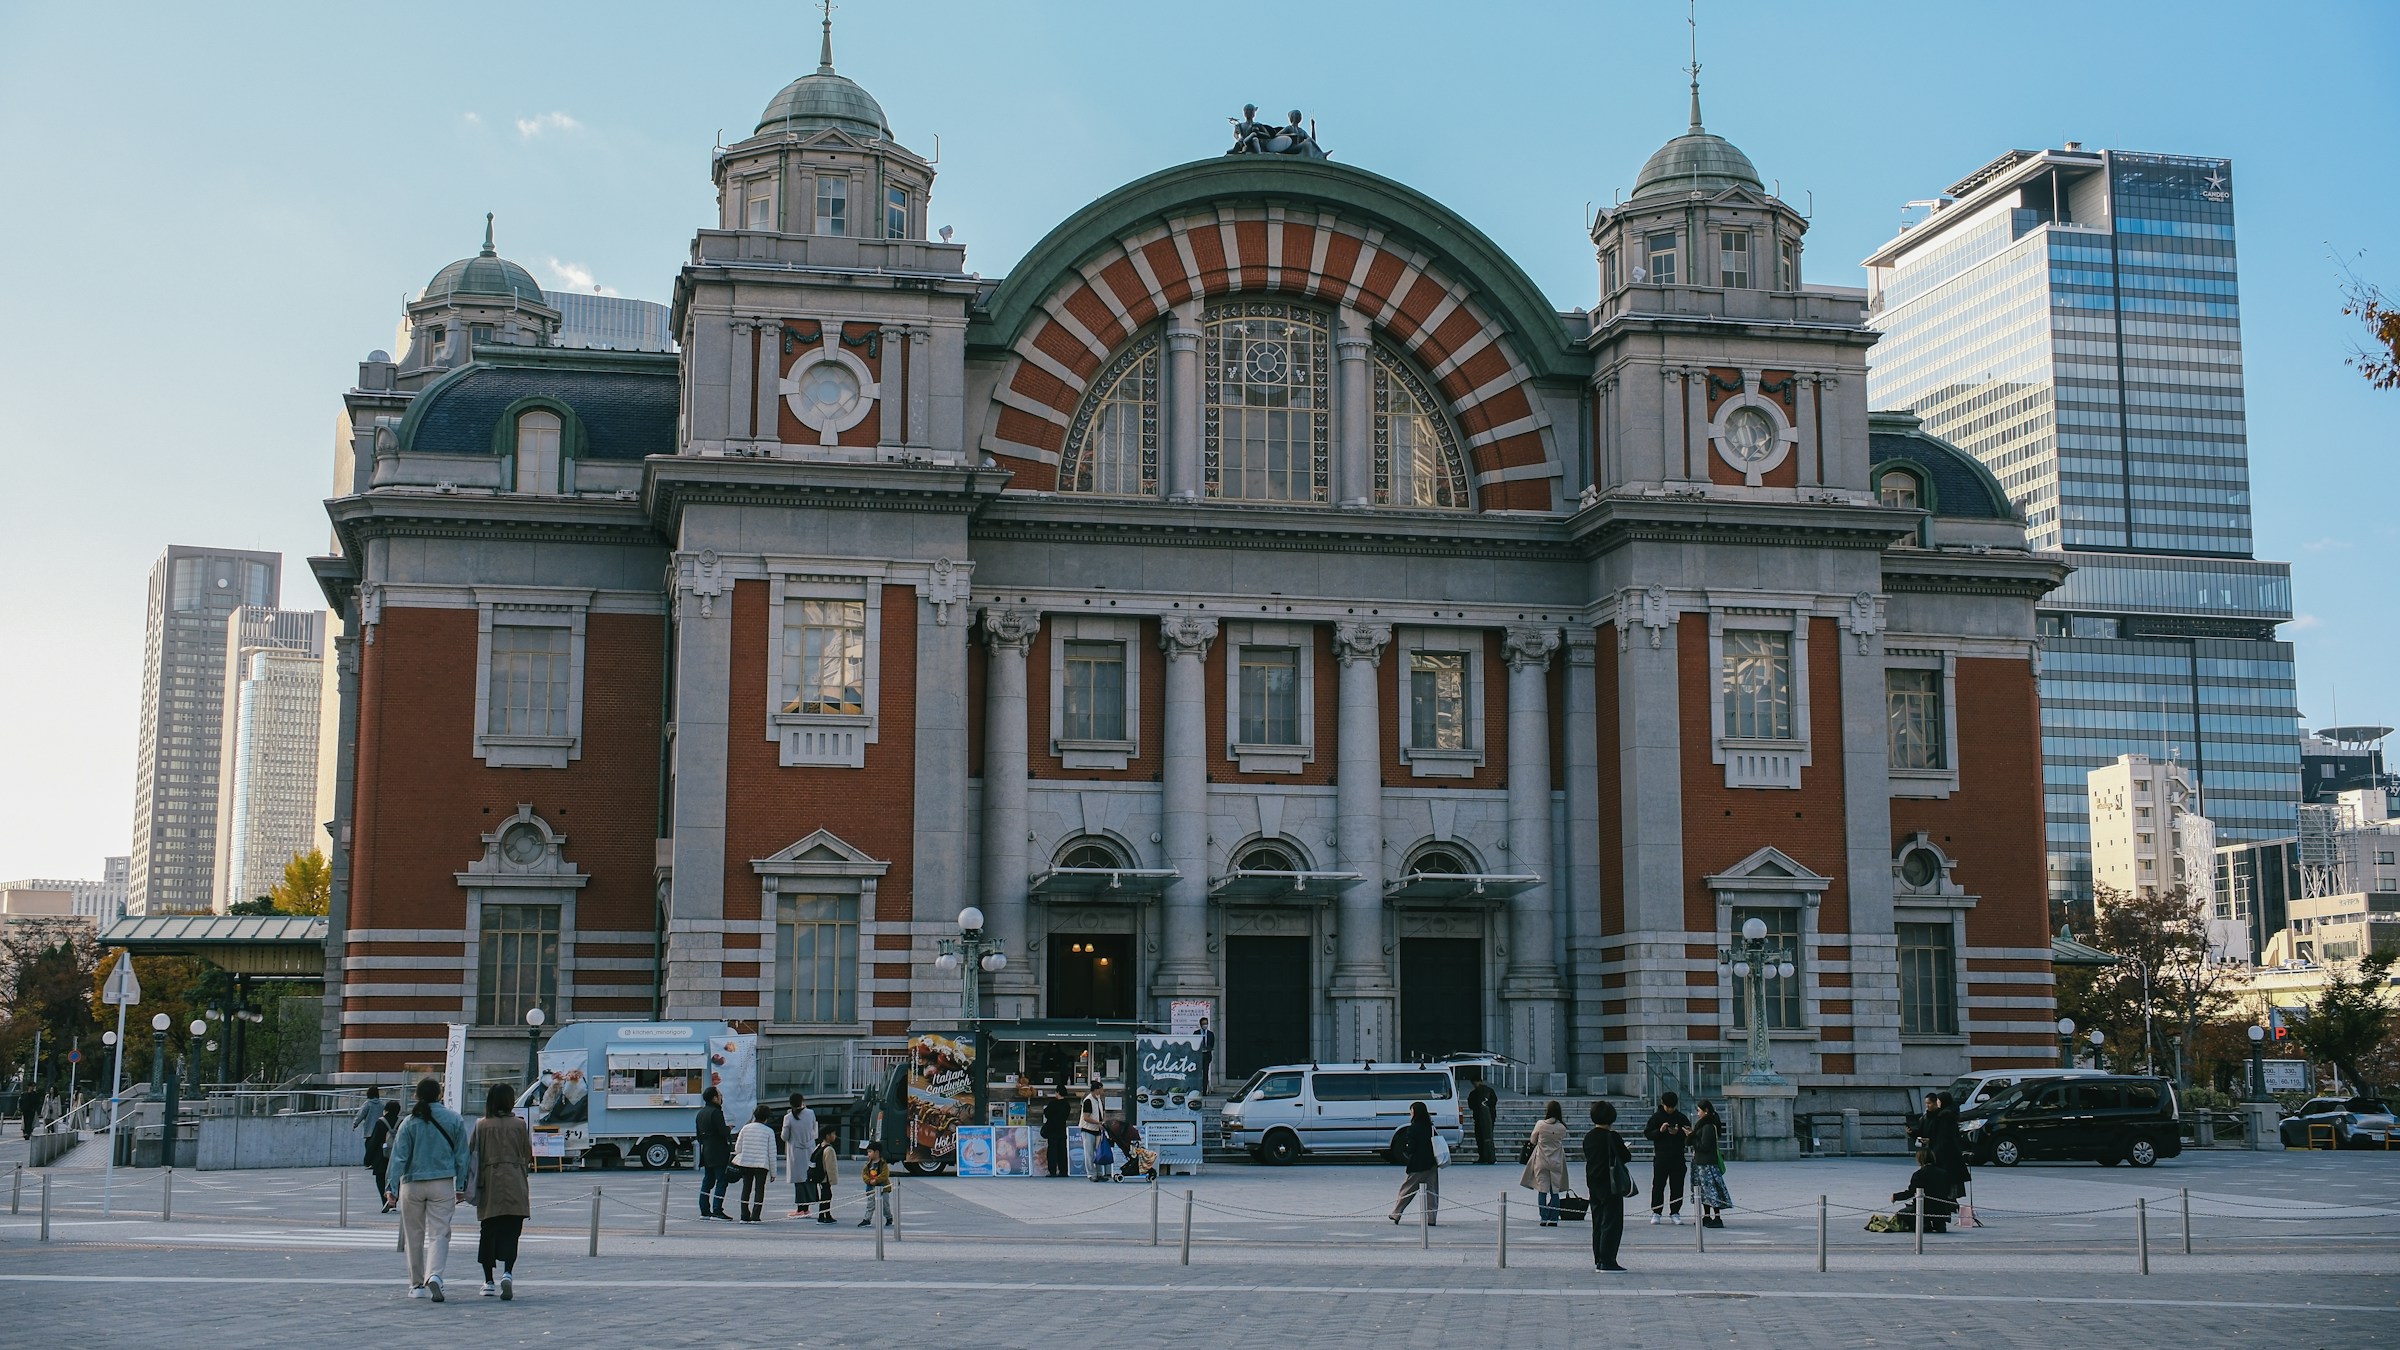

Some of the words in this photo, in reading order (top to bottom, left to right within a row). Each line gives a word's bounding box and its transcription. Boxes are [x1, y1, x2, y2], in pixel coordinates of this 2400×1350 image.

[2275, 1027, 2287, 1040] P
[1143, 1052, 1197, 1076] Gelato
[926, 1074, 972, 1096] Sandwich
[932, 1070, 965, 1086] Italian
[934, 1135, 950, 1150] Hot
[1018, 1148, 1029, 1175] 焼き芋
